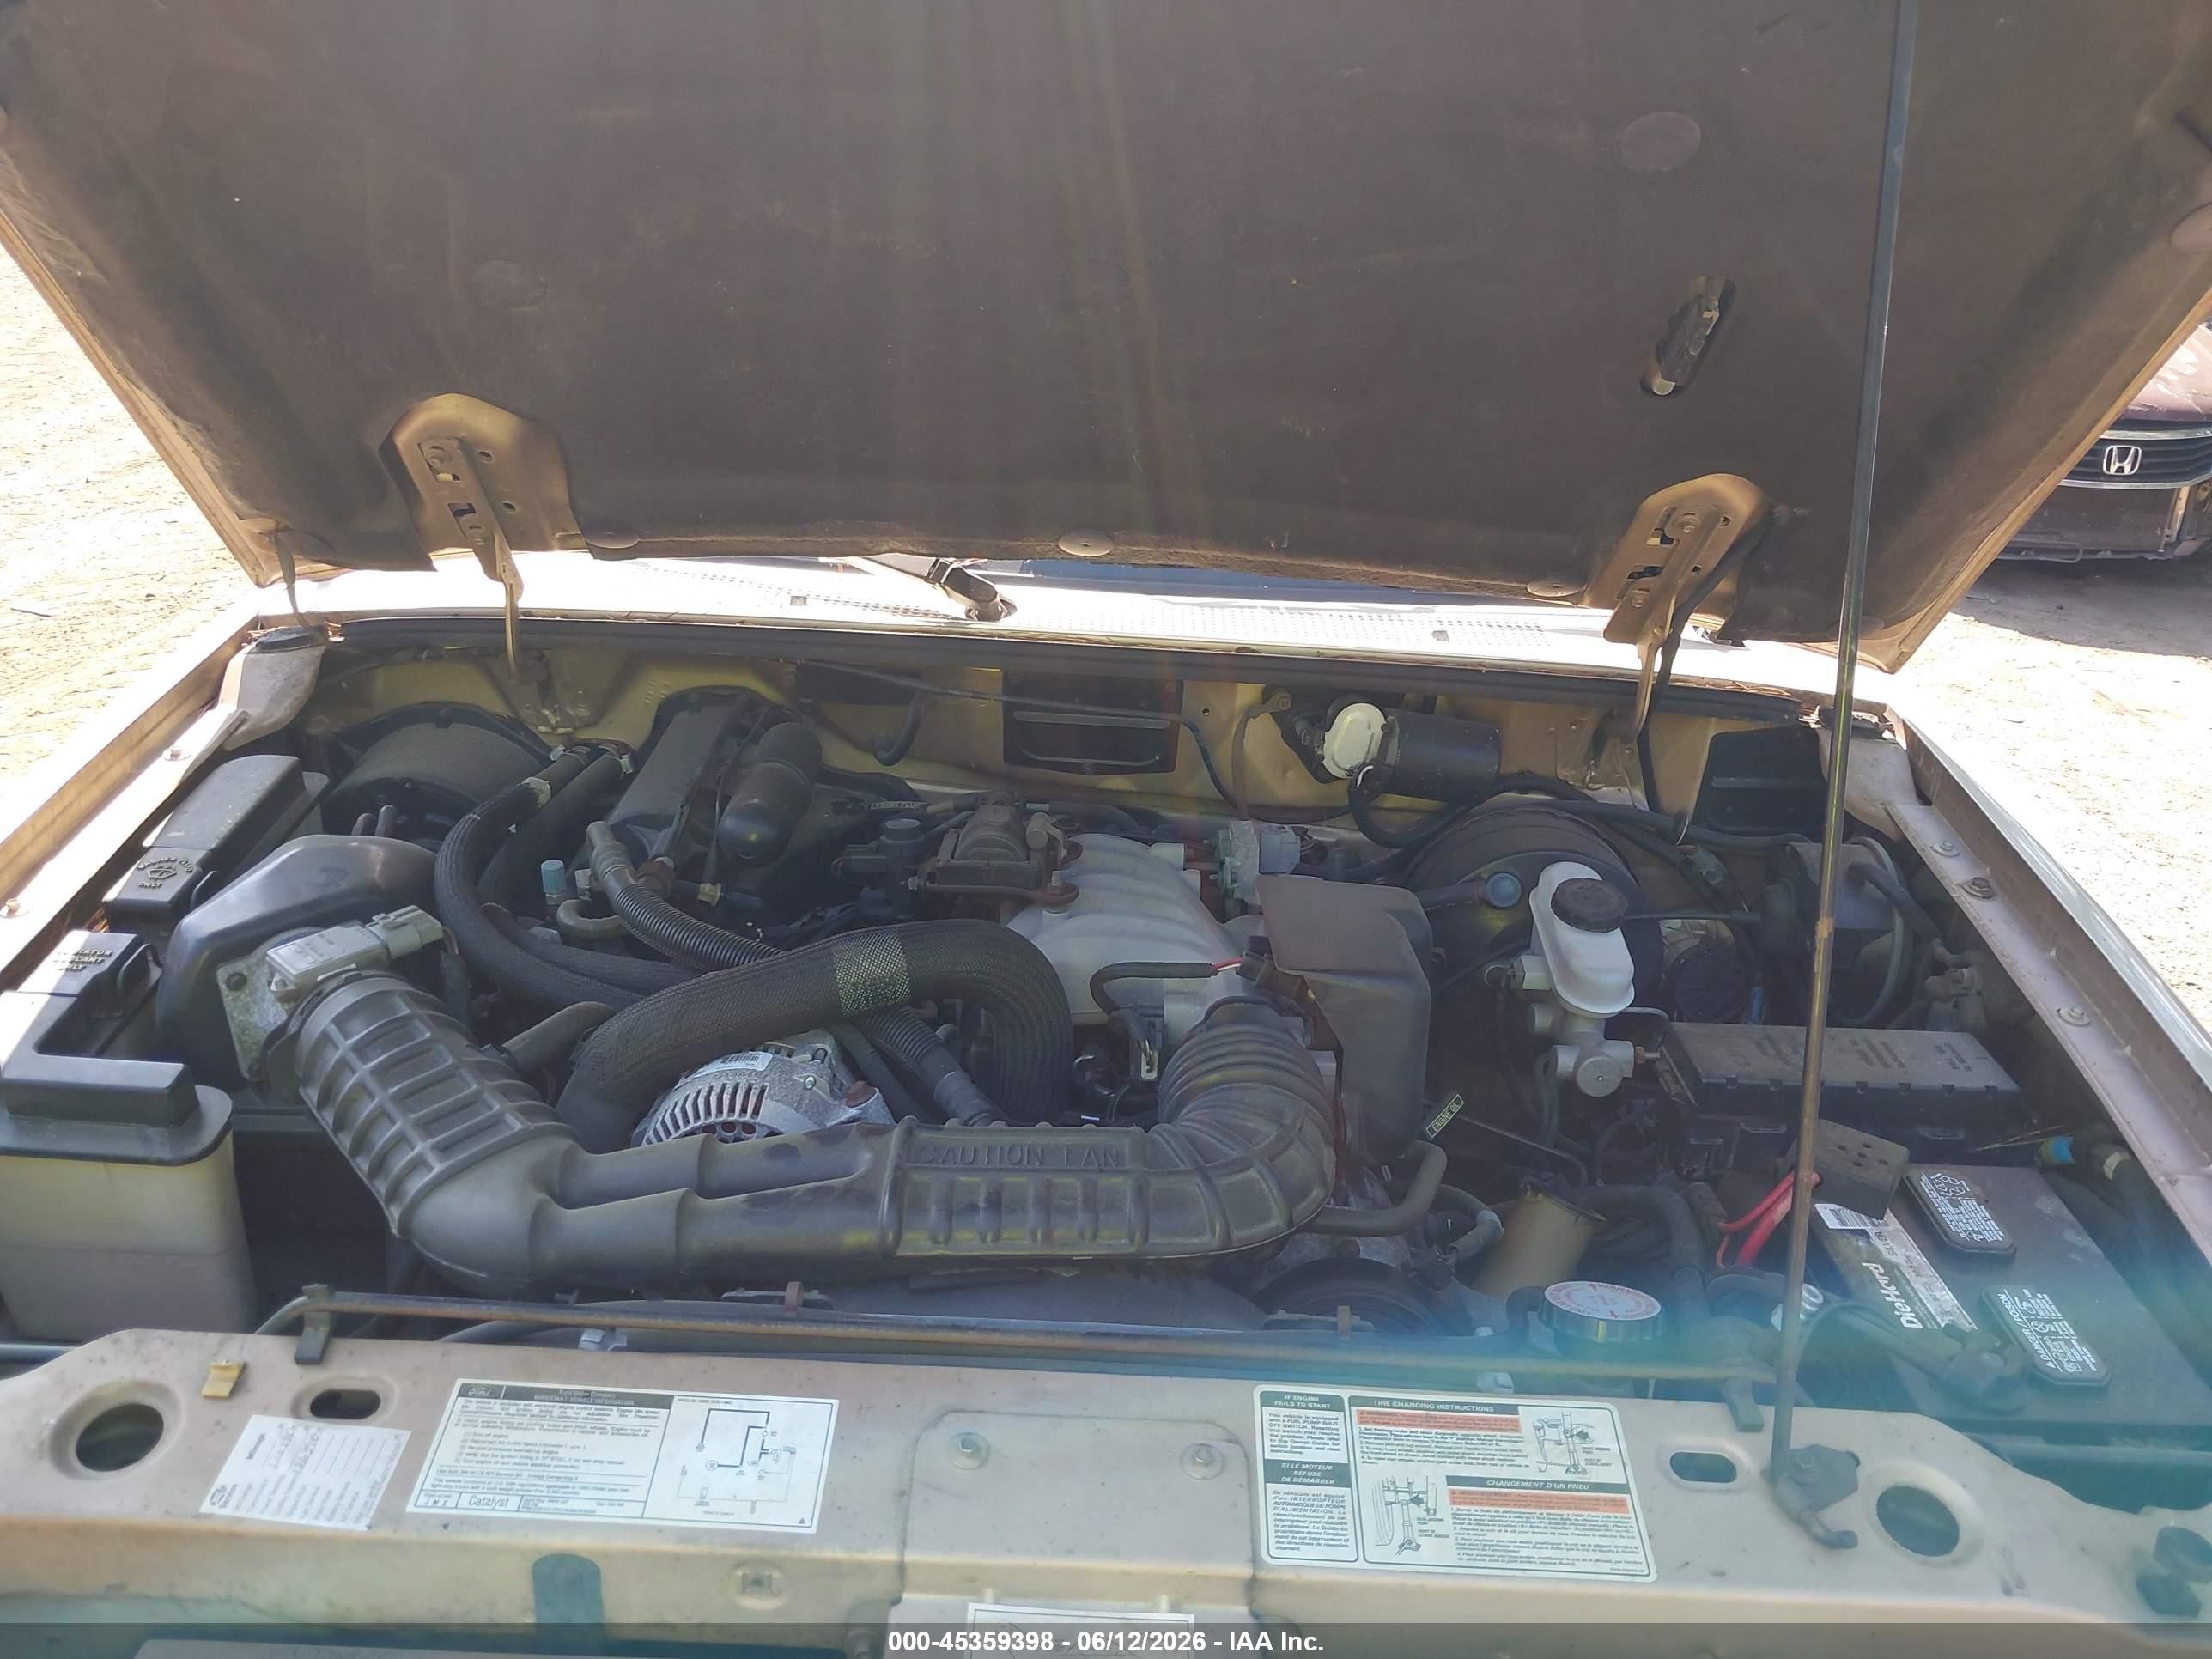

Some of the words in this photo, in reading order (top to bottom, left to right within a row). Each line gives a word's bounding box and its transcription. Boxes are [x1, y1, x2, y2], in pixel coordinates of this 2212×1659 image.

[1432, 1109, 1452, 1132] ENGINE
[1450, 1102, 1460, 1112] OIL
[920, 1146, 1044, 1167] CAUTION
[1874, 1231, 1899, 1257] SILVER
[1862, 1261, 1923, 1329] DieHard
[1997, 1293, 2024, 1322] POISON
[2022, 1328, 2051, 1360] DANGER
[1437, 1404, 1495, 1413] INSTRUCTIONS
[1486, 1480, 1545, 1488] CHANGEMENT
[469, 1496, 509, 1510] Catalyst
